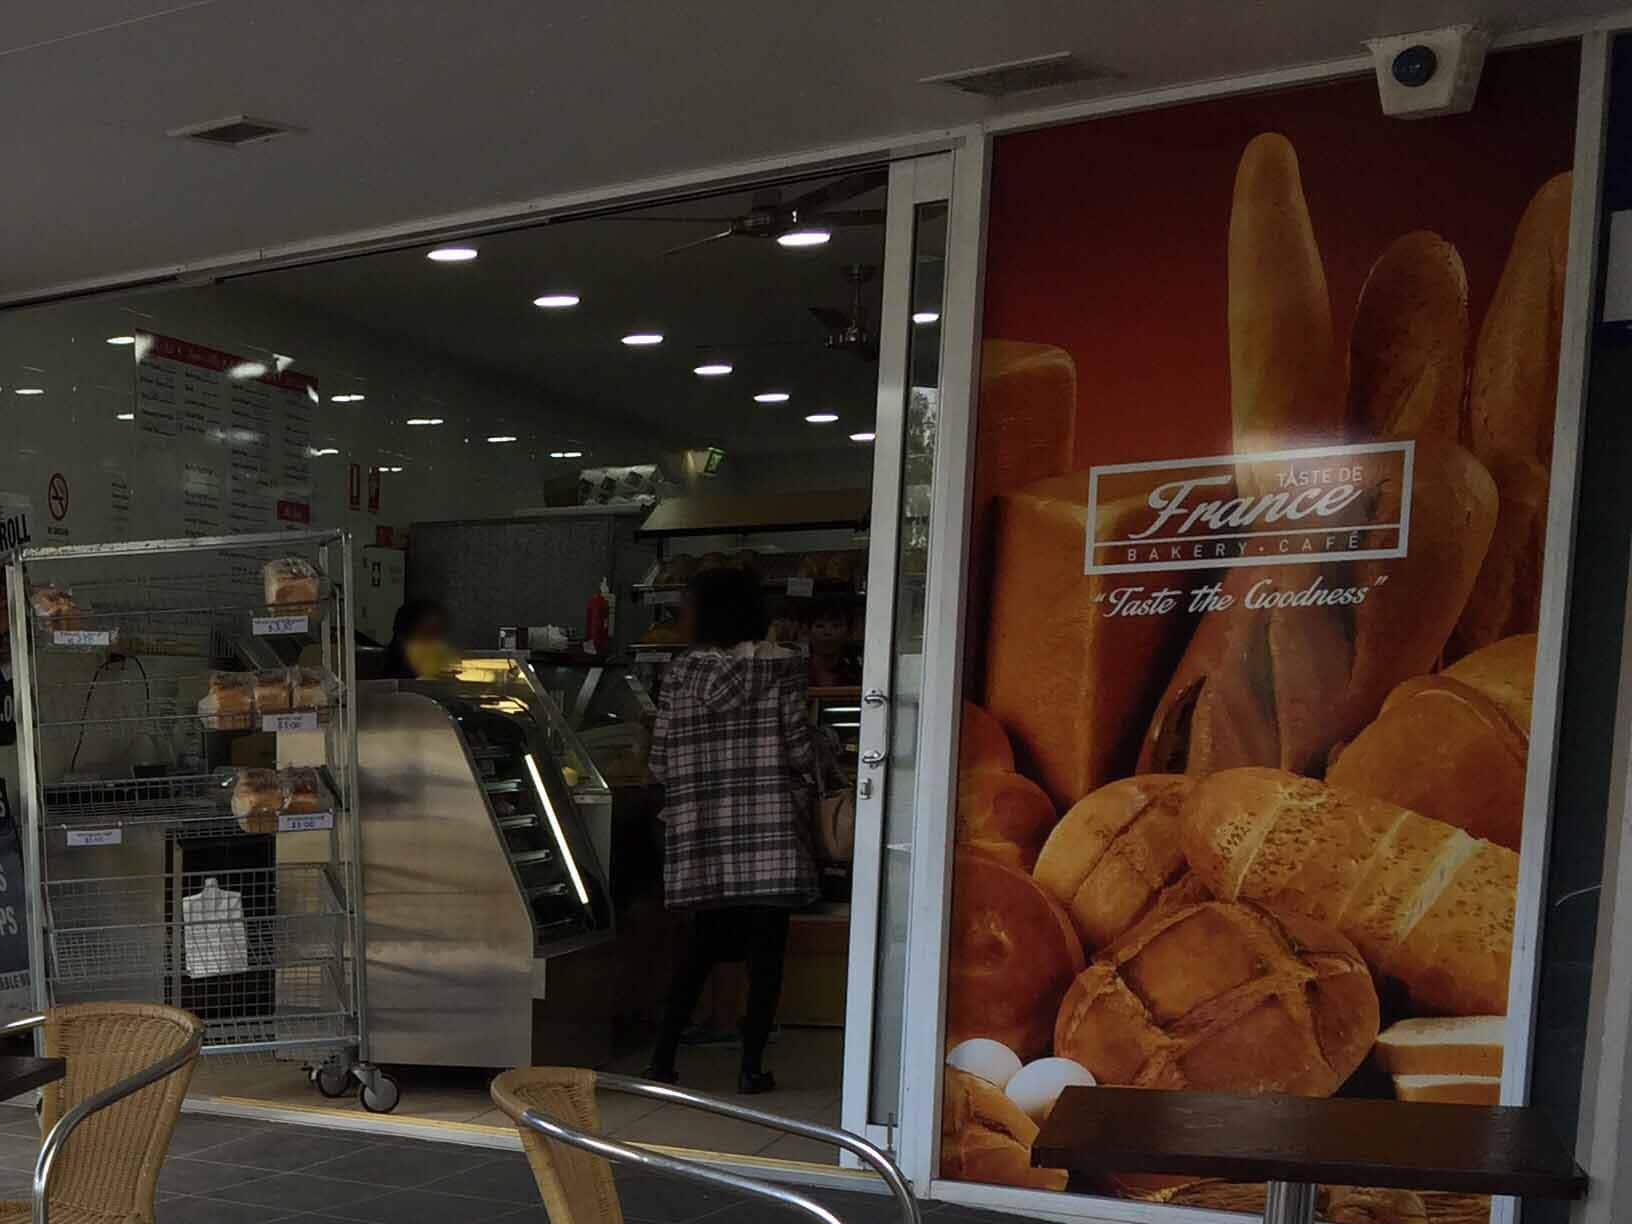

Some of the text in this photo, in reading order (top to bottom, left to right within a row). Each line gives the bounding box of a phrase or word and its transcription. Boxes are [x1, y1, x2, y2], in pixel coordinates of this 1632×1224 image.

[1276, 466, 1364, 488] TASTE DE
[1126, 474, 1363, 540] France
[1127, 530, 1361, 562] BAKERY CAFÉ
[1188, 582, 1235, 613] the
